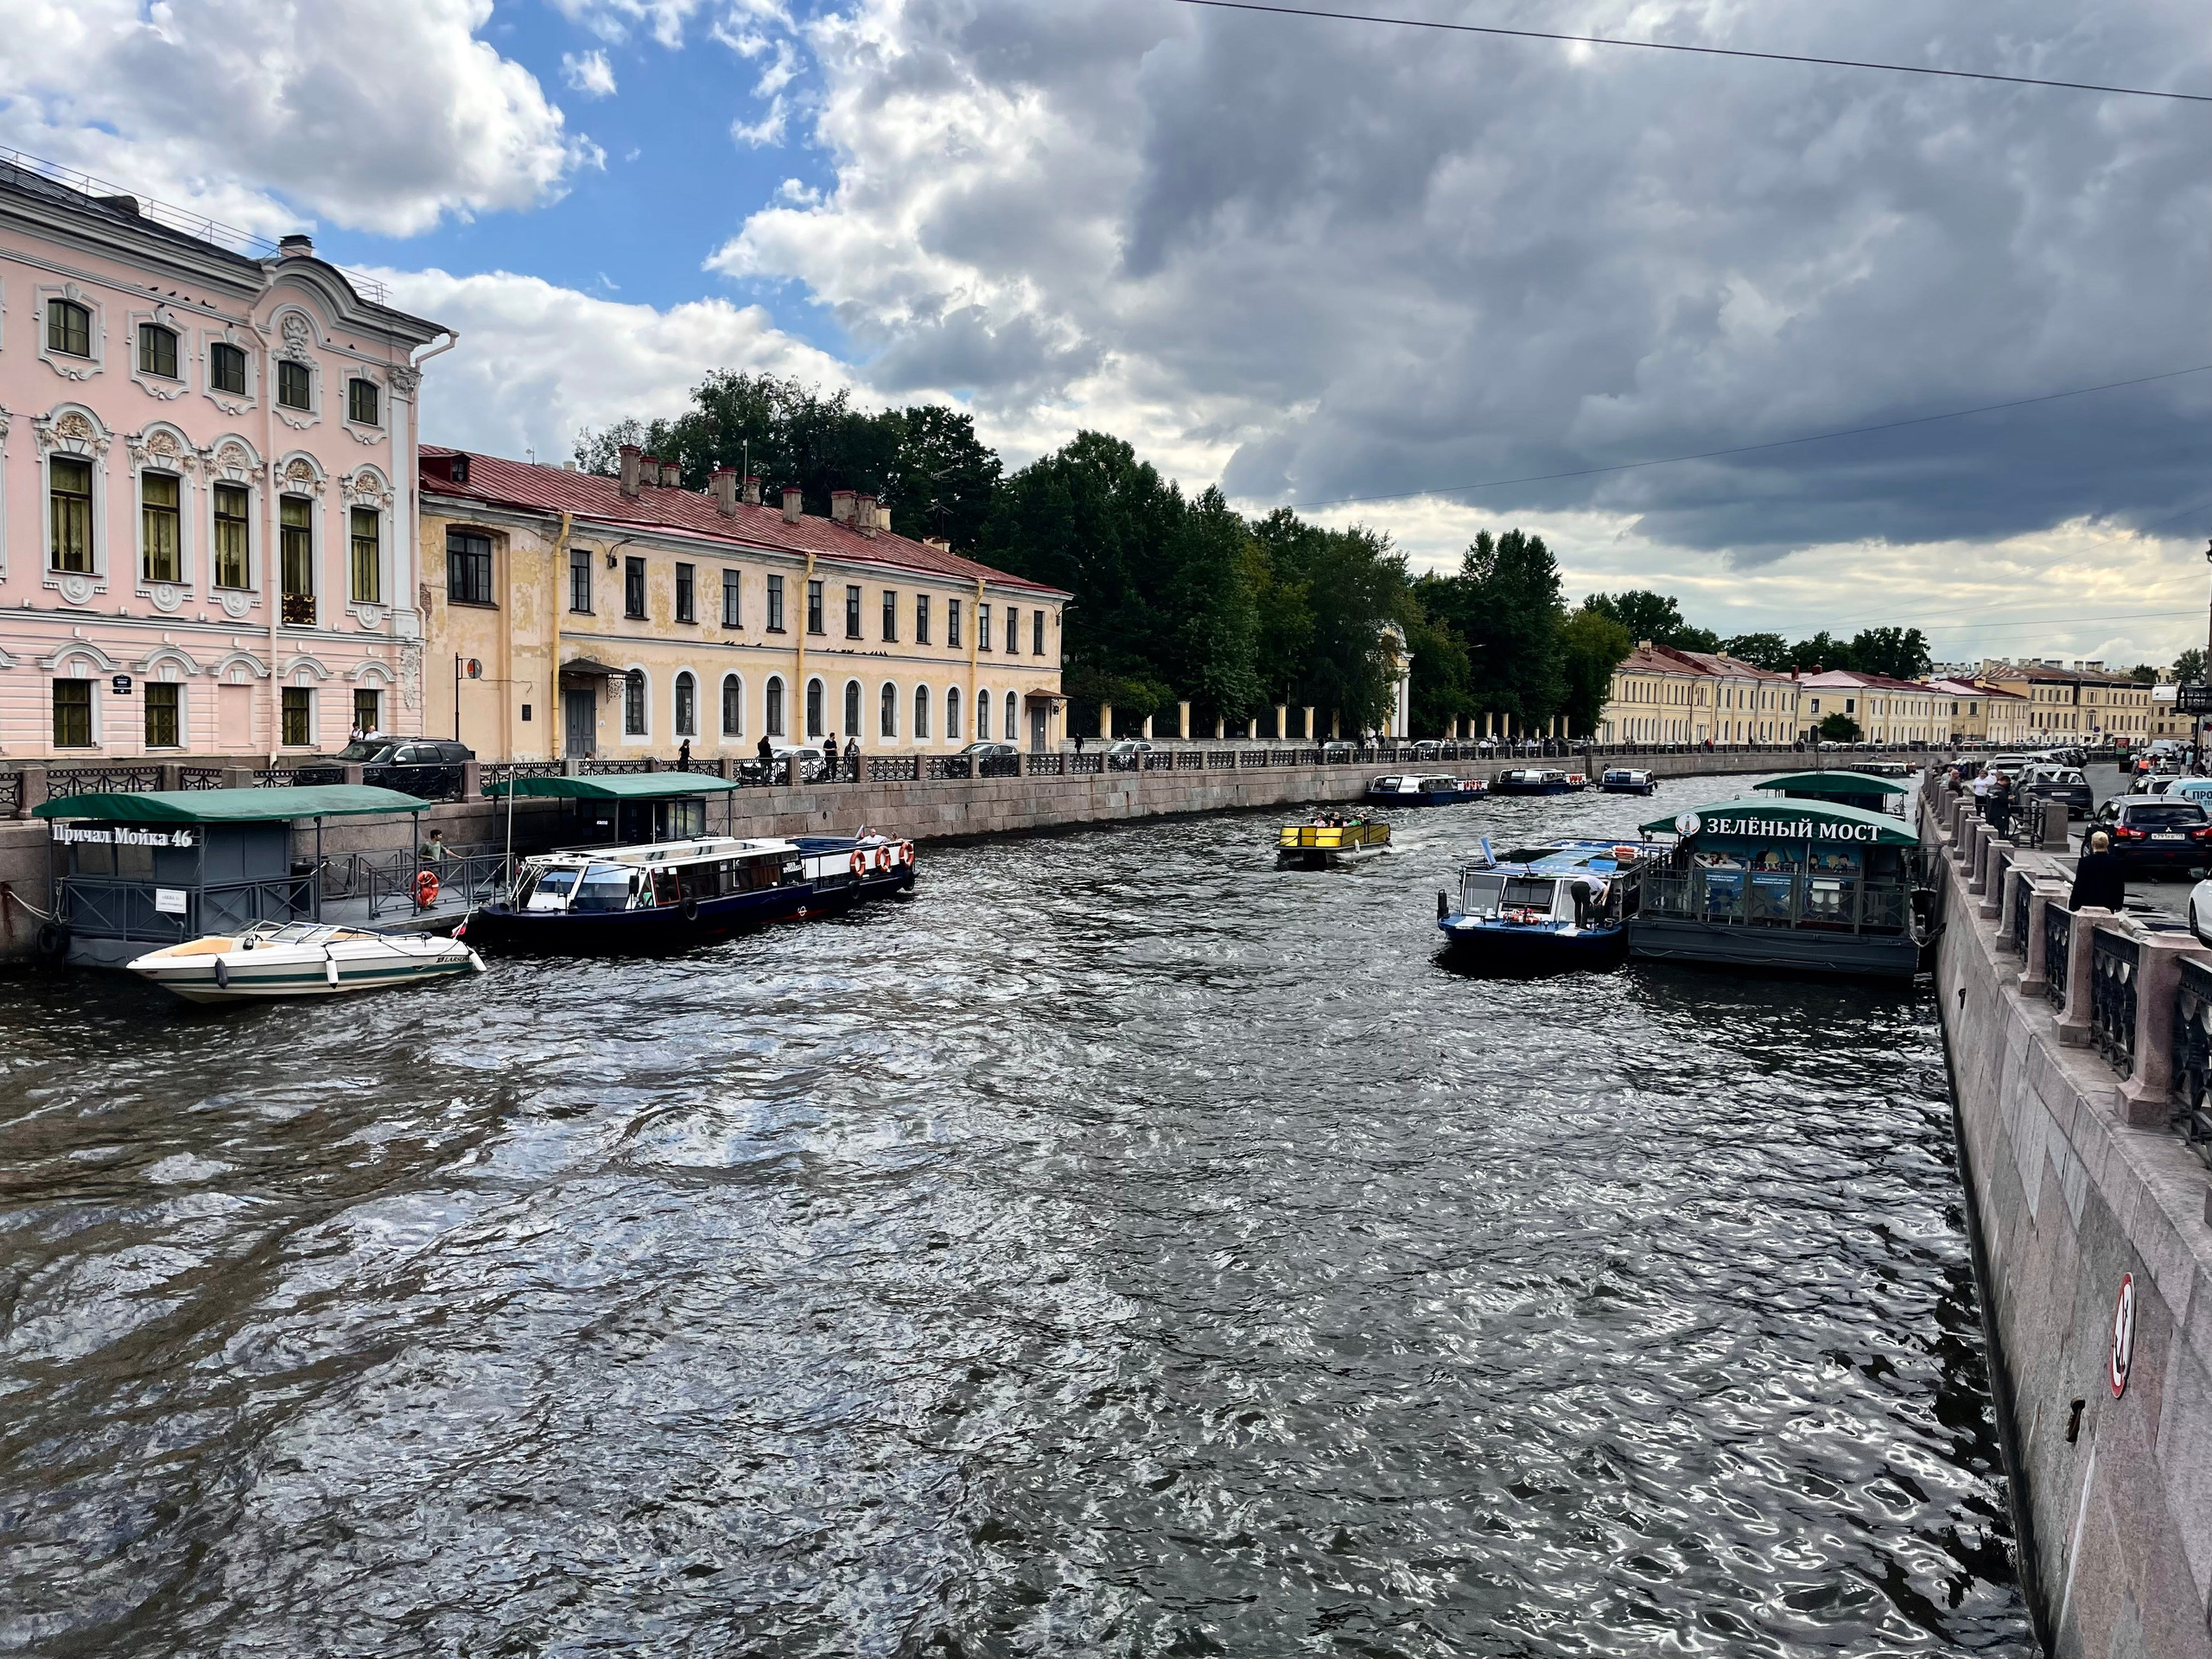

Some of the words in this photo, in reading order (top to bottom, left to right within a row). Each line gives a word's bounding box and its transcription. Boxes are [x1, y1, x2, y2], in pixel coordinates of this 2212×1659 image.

[53, 823, 112, 845] Причал
[114, 827, 169, 847] Мойка
[171, 830, 193, 848] 46
[1707, 817, 1814, 838] ЗЕЛЁНЫЙ
[1818, 823, 1882, 841] МОСТ
